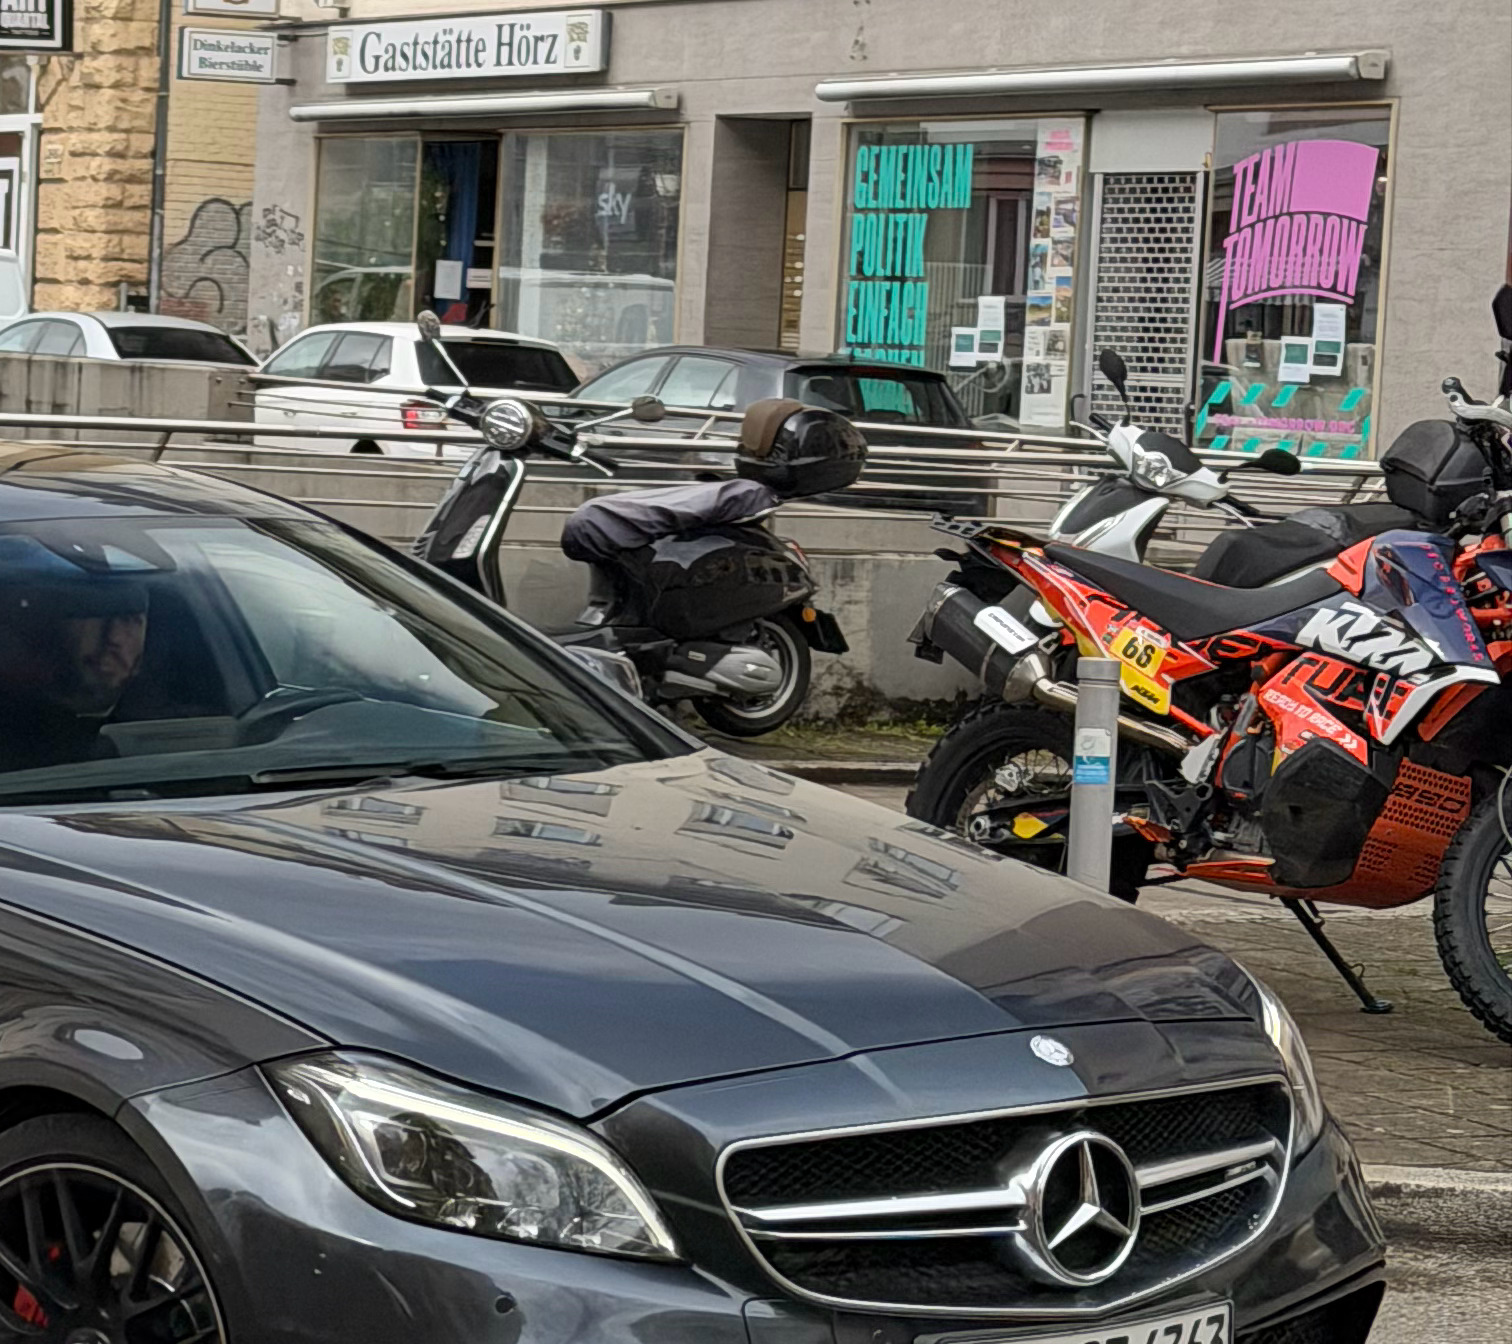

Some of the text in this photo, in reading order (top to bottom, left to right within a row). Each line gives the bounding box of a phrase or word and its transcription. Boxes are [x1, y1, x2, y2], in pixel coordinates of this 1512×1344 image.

[193, 38, 271, 55] Dinkelacker
[359, 22, 559, 75] Gaststätte Hörz
[596, 181, 632, 224] sky
[854, 143, 974, 209] GEMEINSAM
[1230, 142, 1297, 234] TEAM
[849, 212, 928, 277] POLITIK
[1223, 213, 1368, 302] TOMORROW
[846, 280, 928, 346] EINFACH
[1121, 635, 1157, 669] 66
[1295, 601, 1434, 676] KTM
